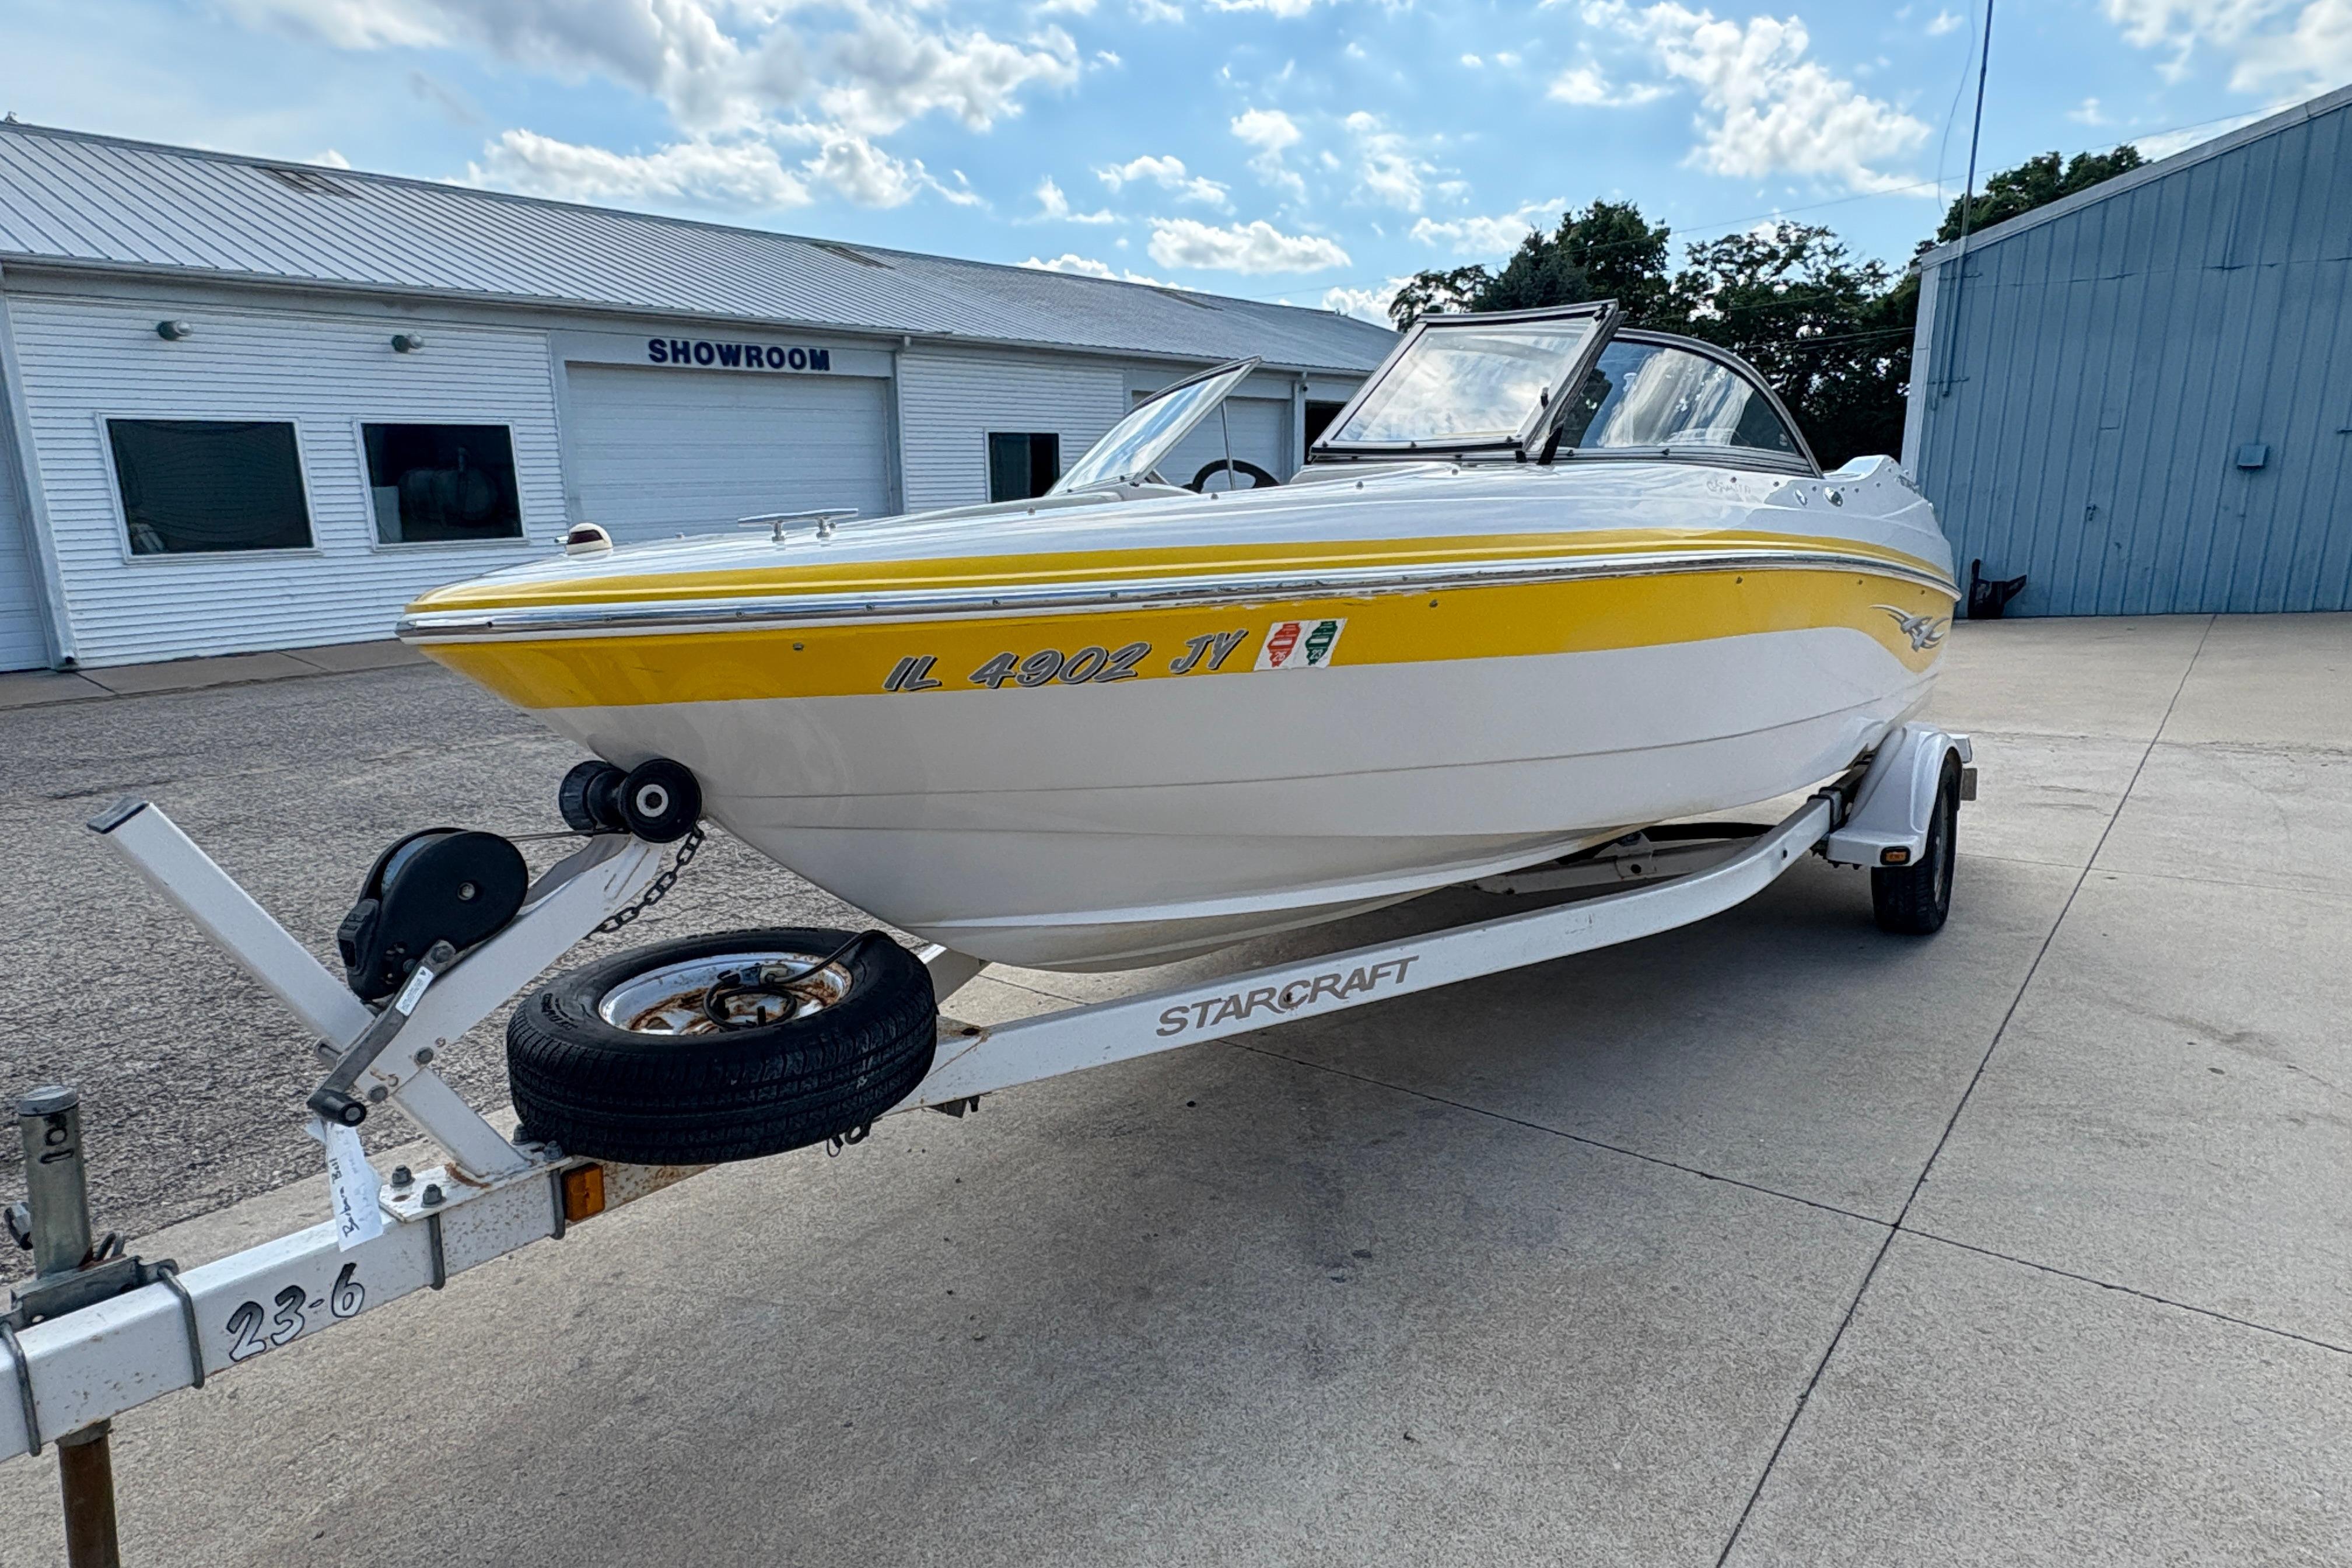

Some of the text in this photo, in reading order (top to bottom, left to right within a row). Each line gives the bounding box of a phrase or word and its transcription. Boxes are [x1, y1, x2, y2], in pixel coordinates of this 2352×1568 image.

[648, 338, 831, 371] SHOWROOM
[883, 655, 942, 691] IL
[969, 642, 1153, 689] 4902
[1169, 629, 1248, 674] JY
[1156, 956, 1419, 1037] STARCRAFT
[227, 1262, 365, 1362] 23-6
